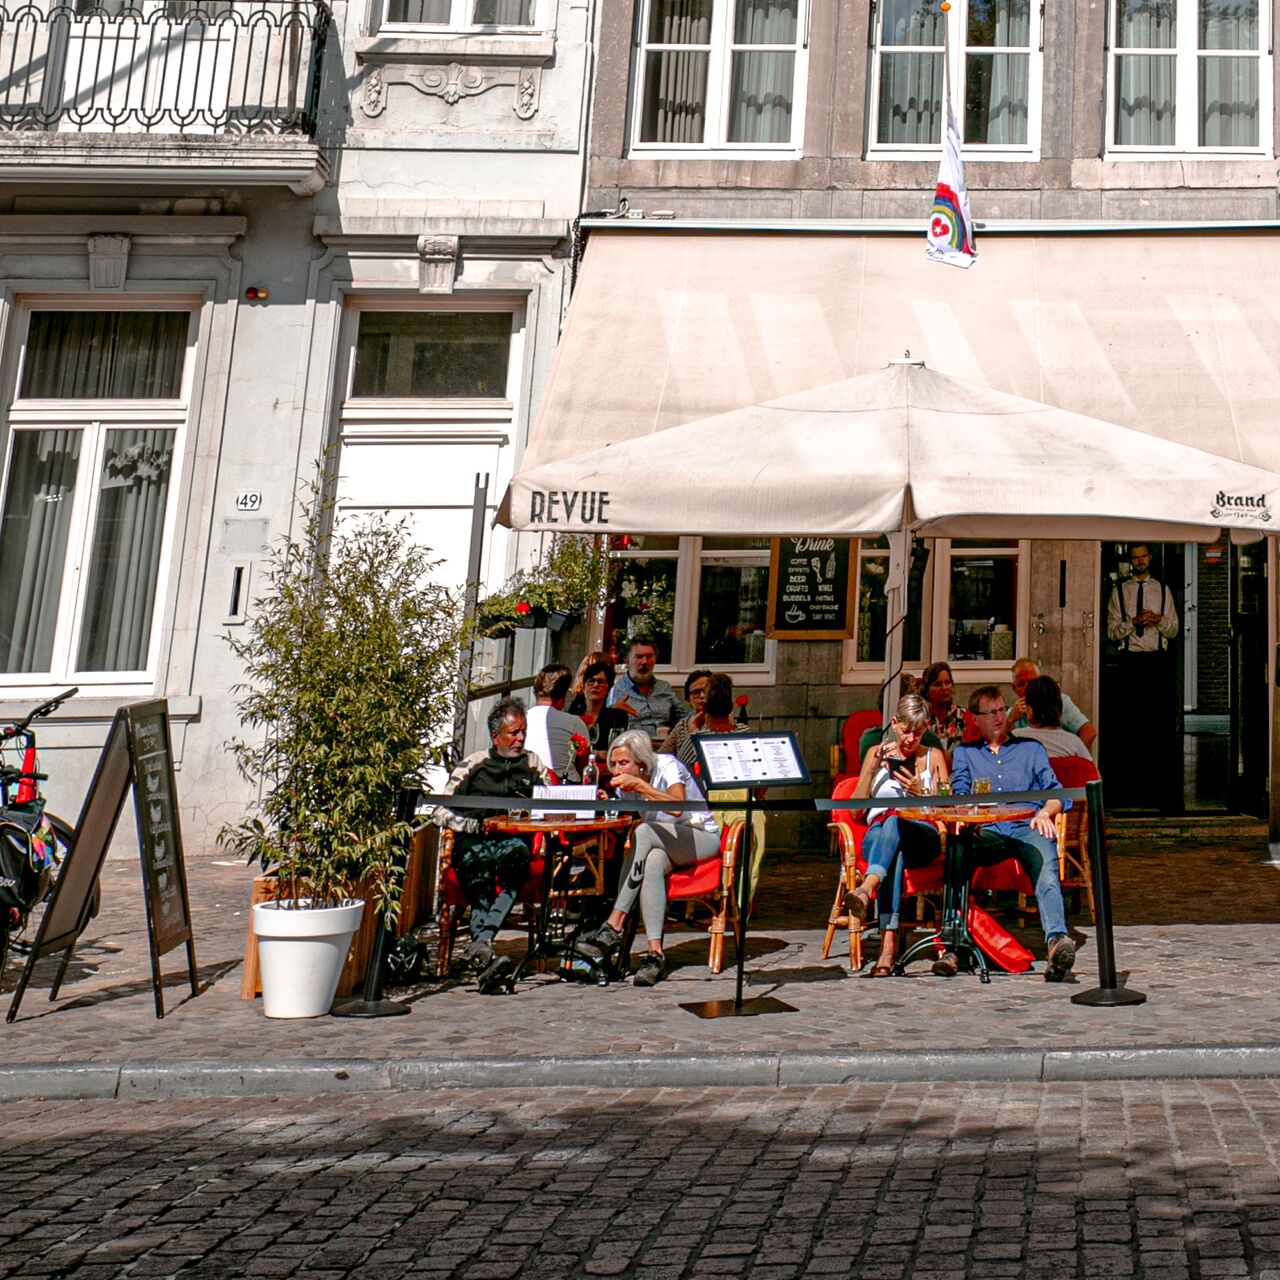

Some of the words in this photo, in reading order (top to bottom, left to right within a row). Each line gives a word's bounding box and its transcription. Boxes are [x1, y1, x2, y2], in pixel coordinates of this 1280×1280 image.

[239, 493, 259, 509] 49
[530, 491, 610, 524] REVUE
[1215, 490, 1267, 508] Brand
[791, 537, 835, 554] Drink
[789, 575, 807, 583] BEER
